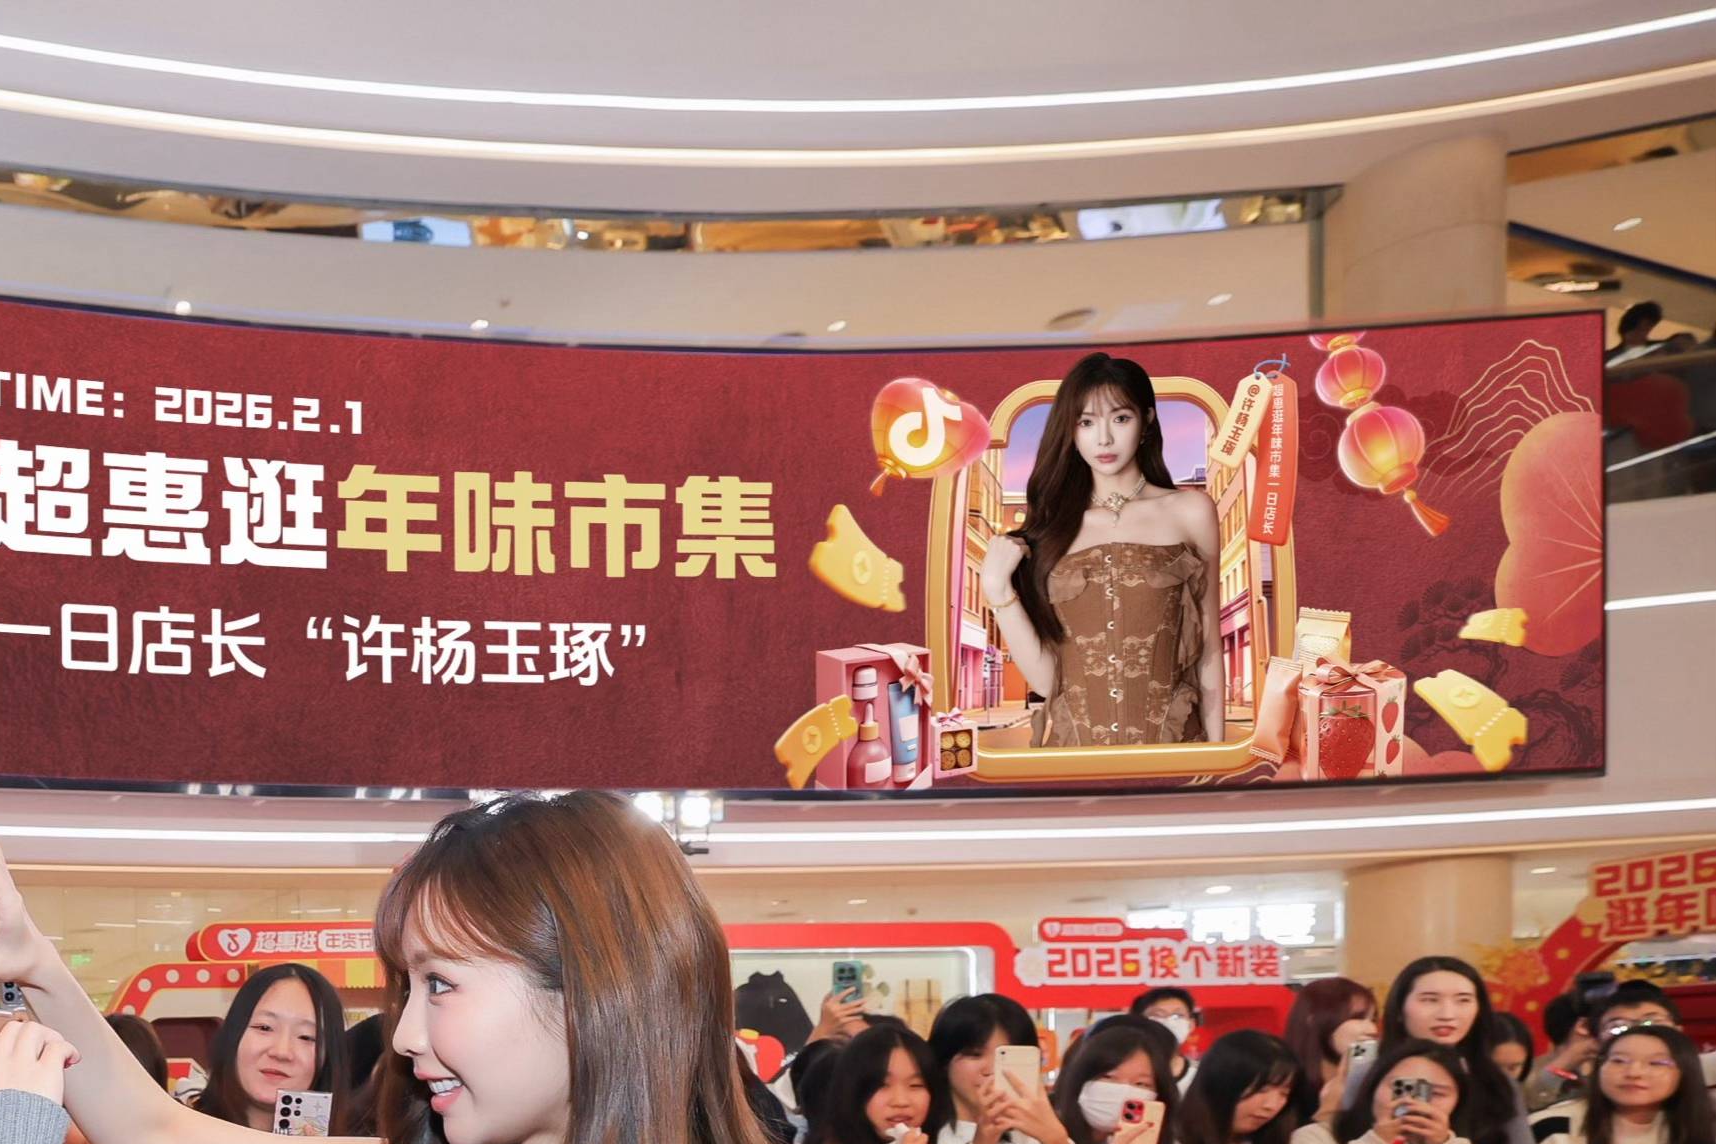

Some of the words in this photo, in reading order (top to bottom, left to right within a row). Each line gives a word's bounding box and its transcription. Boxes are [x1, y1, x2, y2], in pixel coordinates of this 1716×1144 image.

[154, 386, 363, 435] 2026.2.1
[1046, 946, 1281, 979] 2026换个新装
